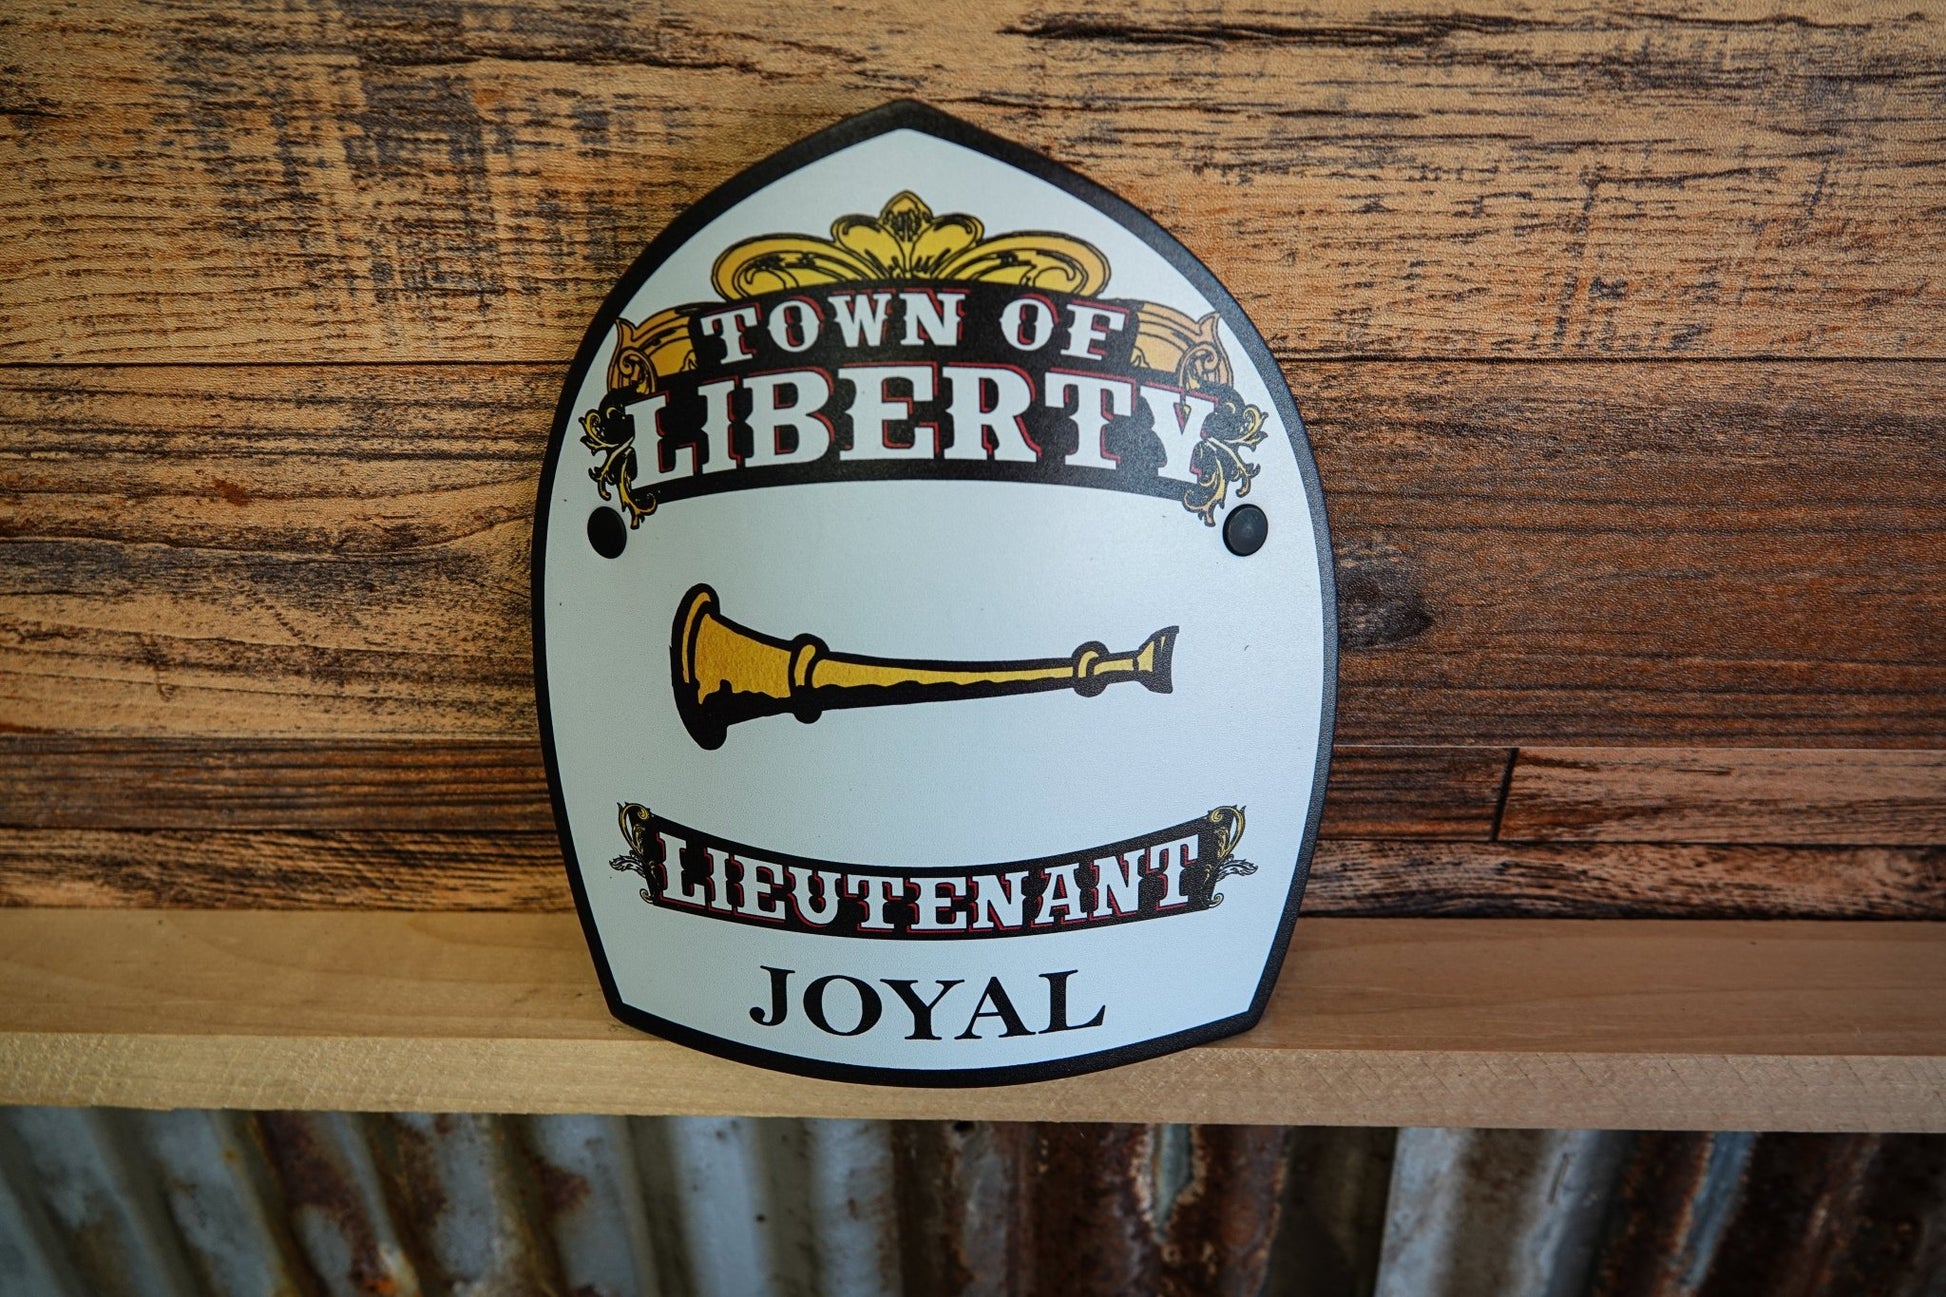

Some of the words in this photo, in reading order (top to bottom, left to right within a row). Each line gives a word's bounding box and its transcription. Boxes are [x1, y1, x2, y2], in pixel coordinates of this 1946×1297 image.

[700, 290, 966, 364] TOWN
[998, 297, 1128, 361] OF
[624, 361, 1218, 488] LIBERTY
[654, 831, 1202, 934] LIEUTENANT
[748, 964, 1106, 1041] JOYAL
